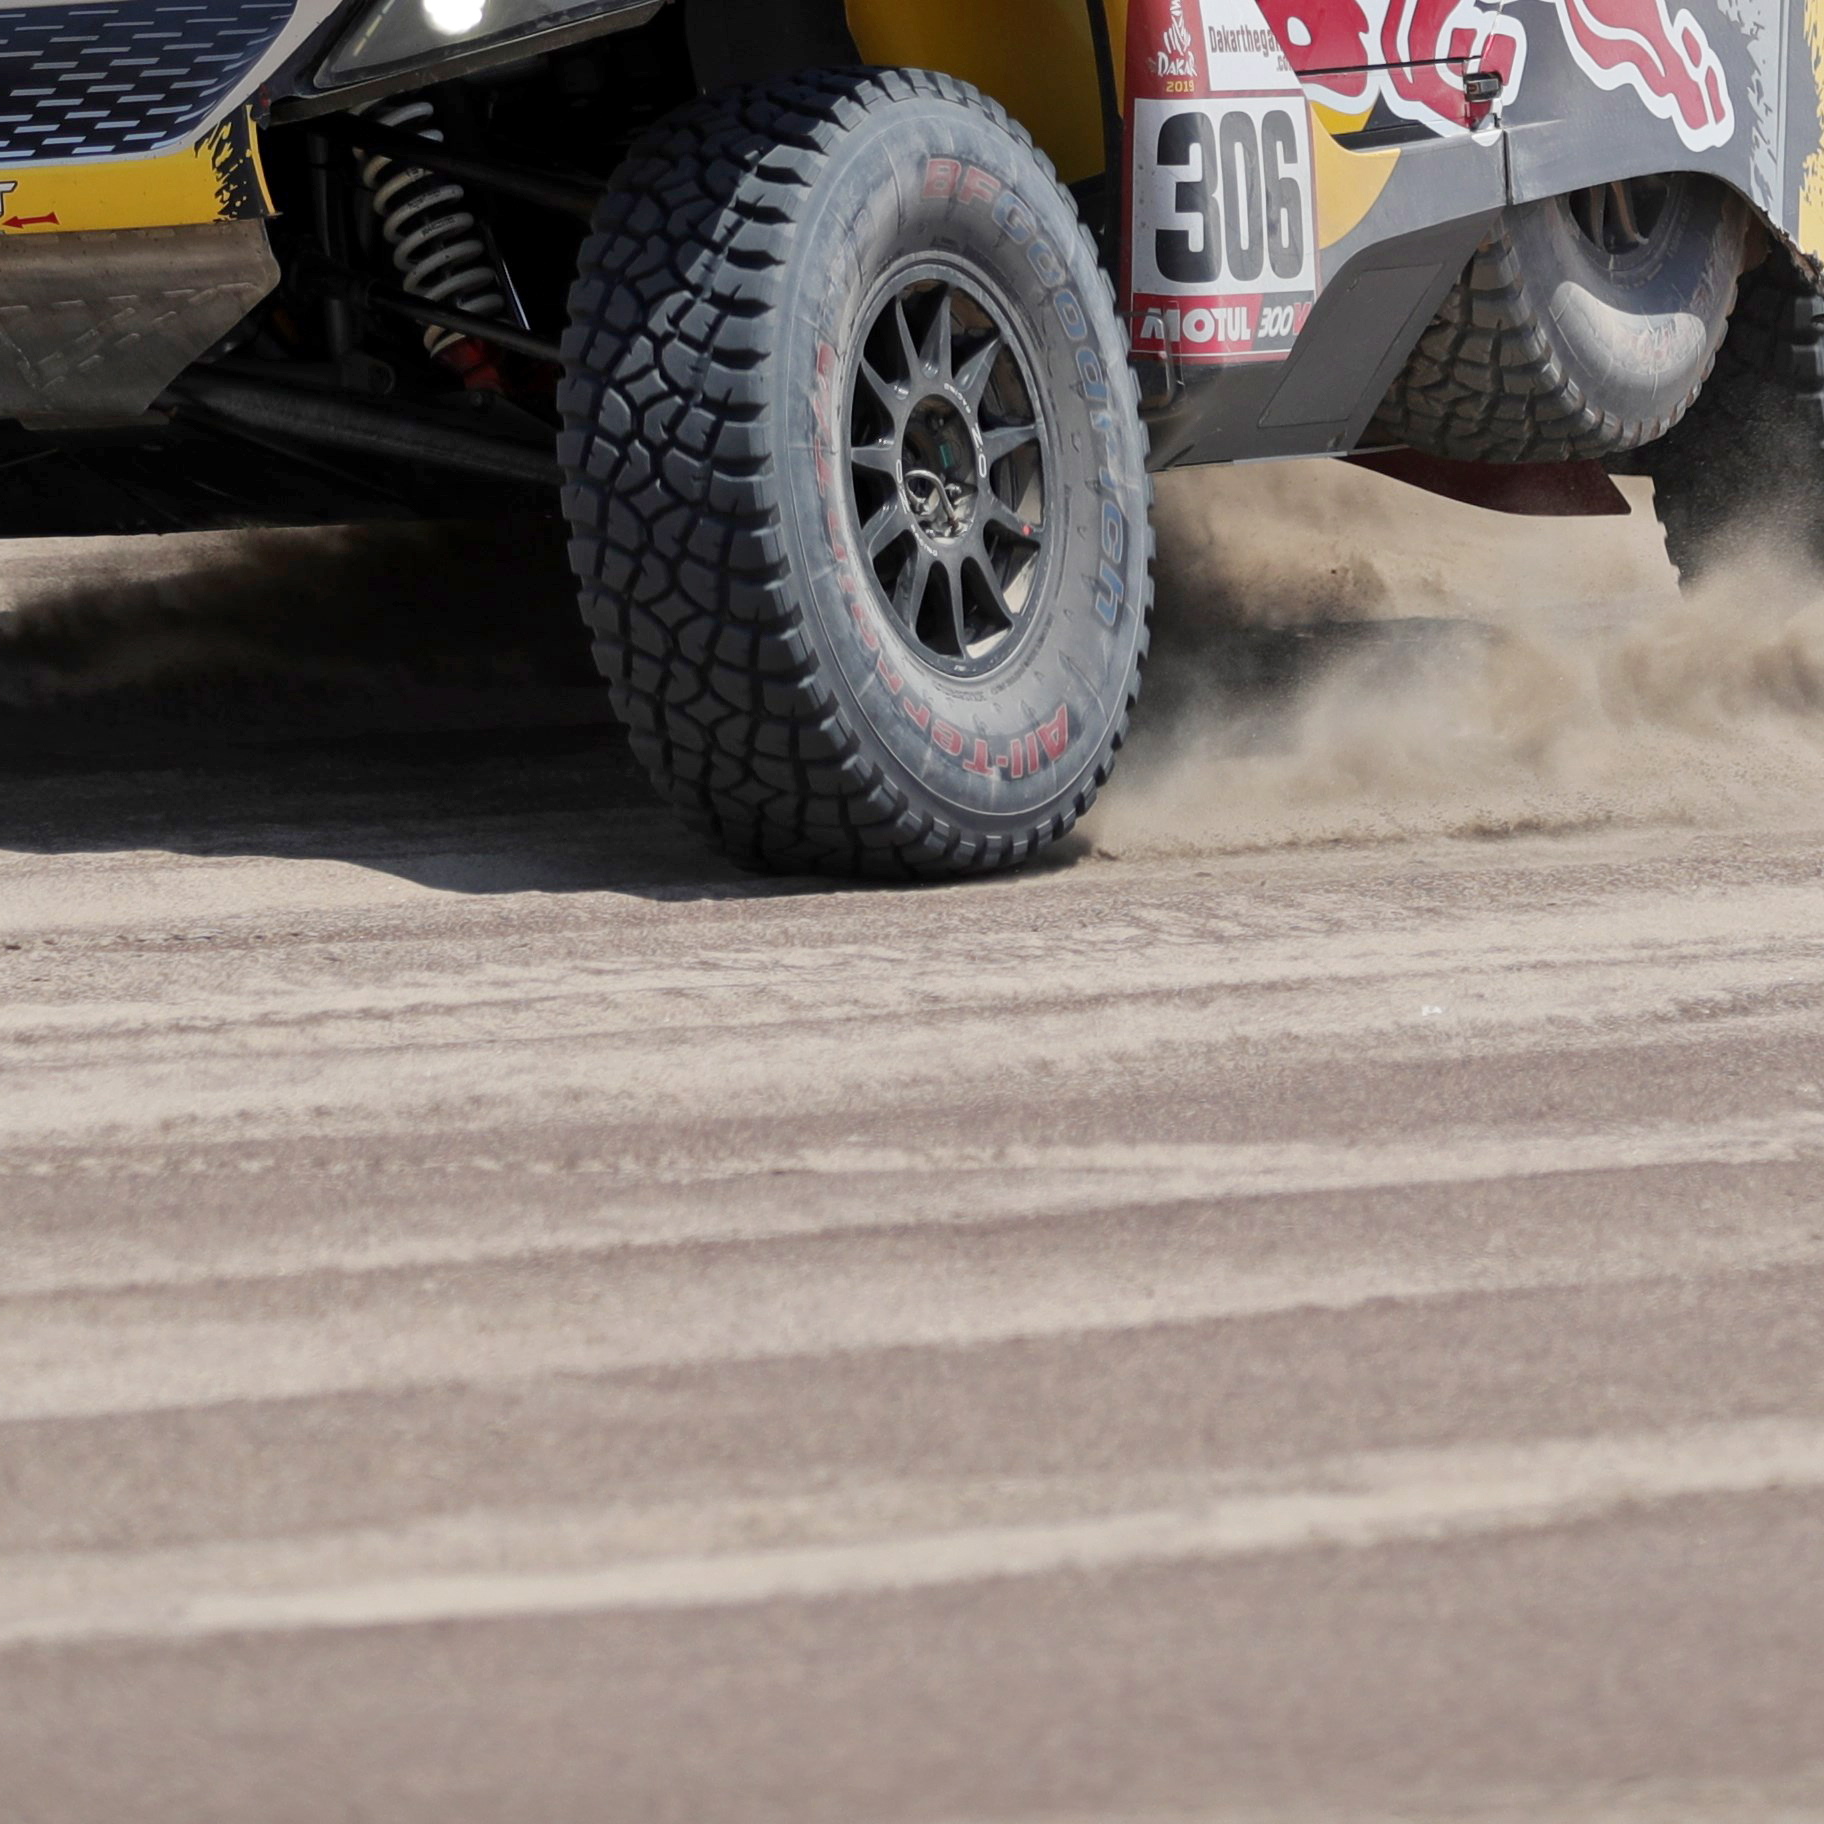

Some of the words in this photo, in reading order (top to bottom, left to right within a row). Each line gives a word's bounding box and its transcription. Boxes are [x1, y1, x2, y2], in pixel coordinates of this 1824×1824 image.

[1157, 50, 1198, 78] DAKAR
[1165, 79, 1195, 93] 2019
[1155, 109, 1305, 284] 306
[1139, 306, 1251, 344] MOTUL
[1257, 301, 1312, 338] 300V
